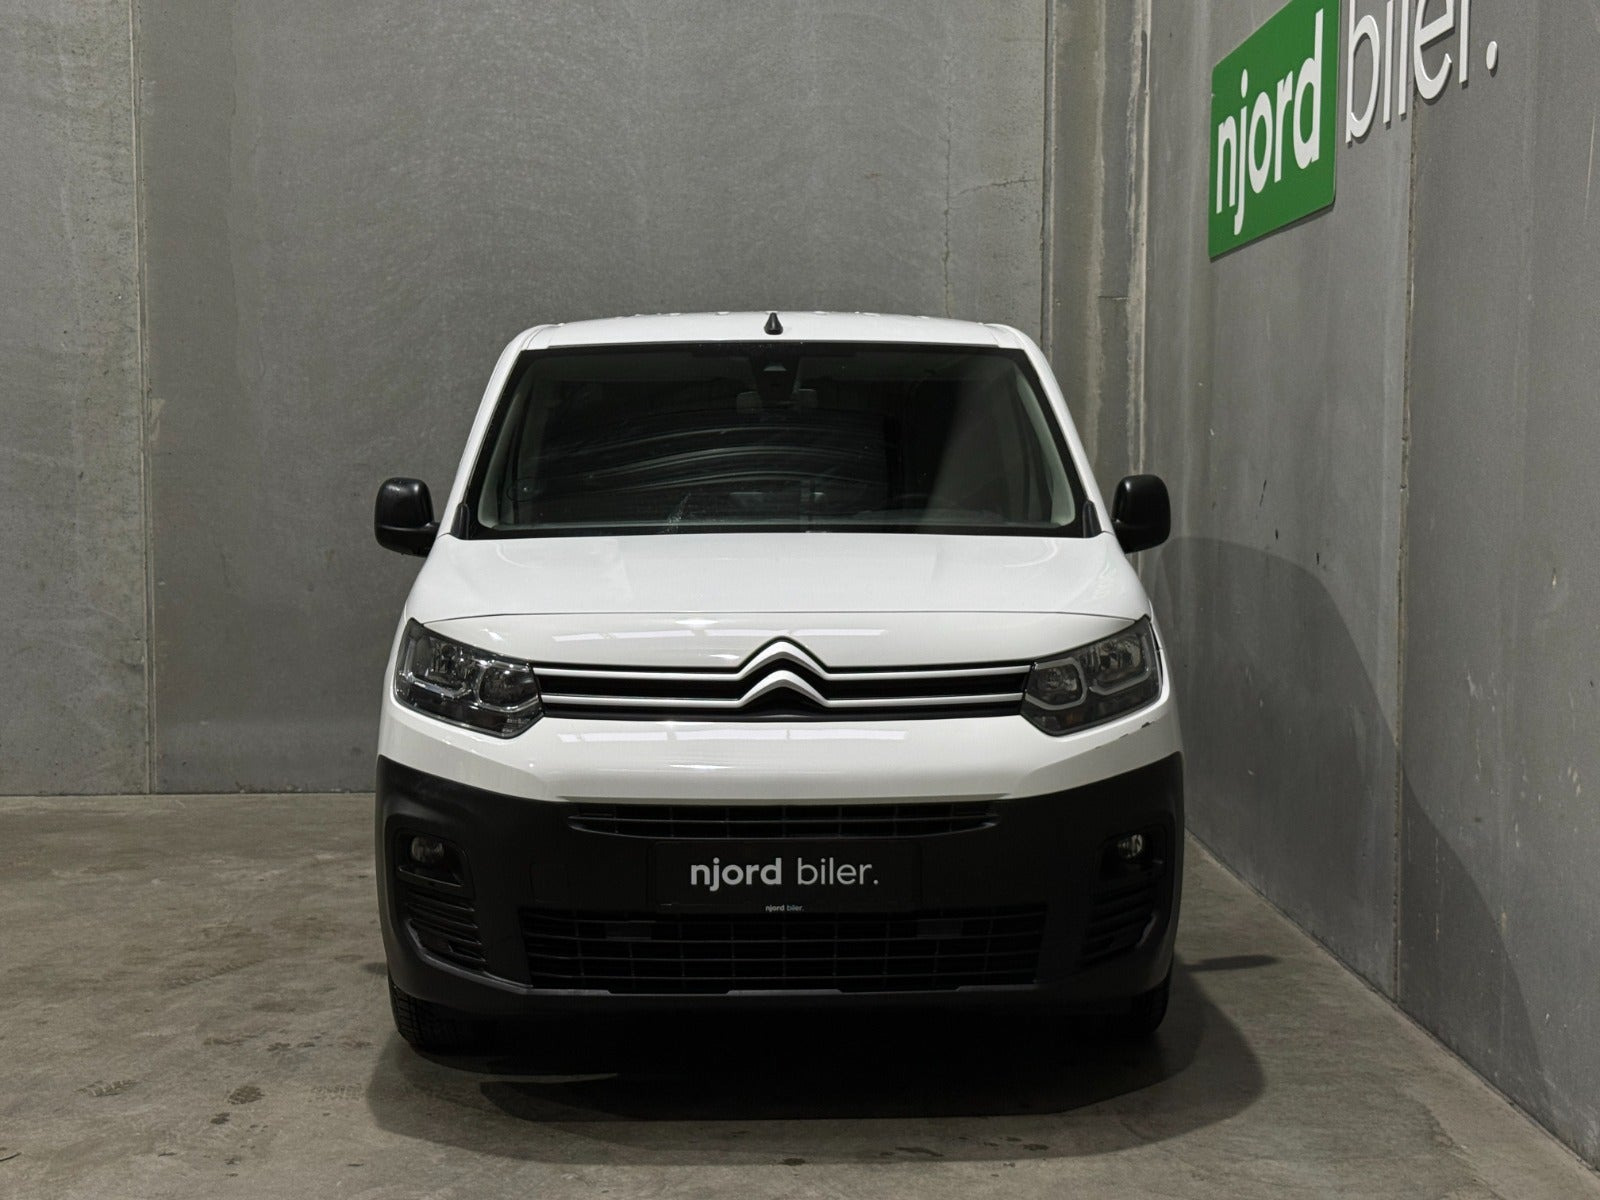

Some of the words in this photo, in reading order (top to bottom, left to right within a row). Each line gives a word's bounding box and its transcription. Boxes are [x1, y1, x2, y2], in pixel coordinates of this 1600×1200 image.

[1216, 8, 1324, 235] njord
[690, 857, 782, 892] njord
[797, 857, 879, 886] biler.
[765, 904, 785, 912] njord
